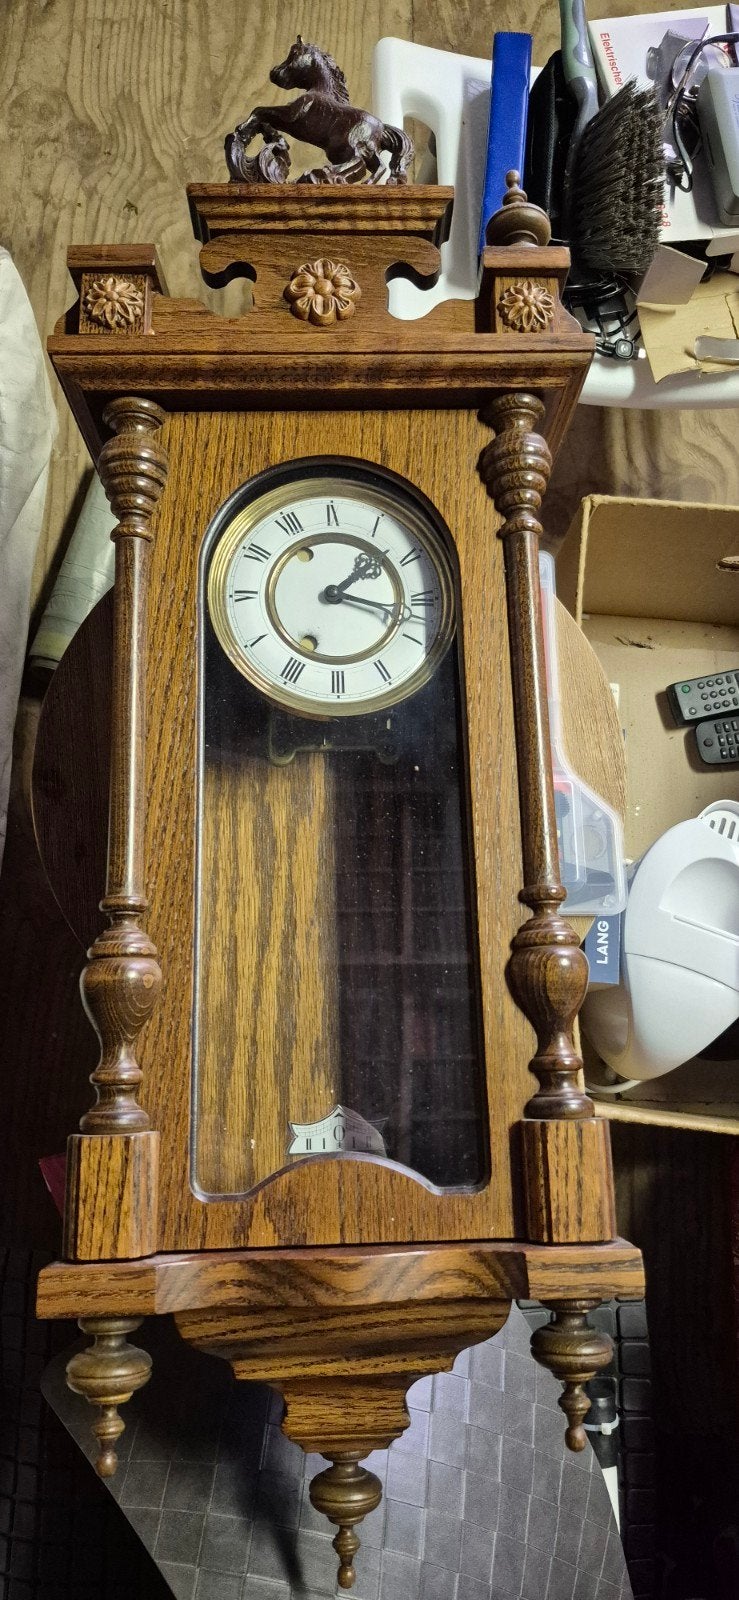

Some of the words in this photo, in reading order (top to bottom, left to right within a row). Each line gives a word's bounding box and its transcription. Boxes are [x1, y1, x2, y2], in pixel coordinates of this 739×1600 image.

[599, 32, 623, 86] Elektrischer
[331, 670, 345, 694] III
[596, 920, 609, 965] LANG
